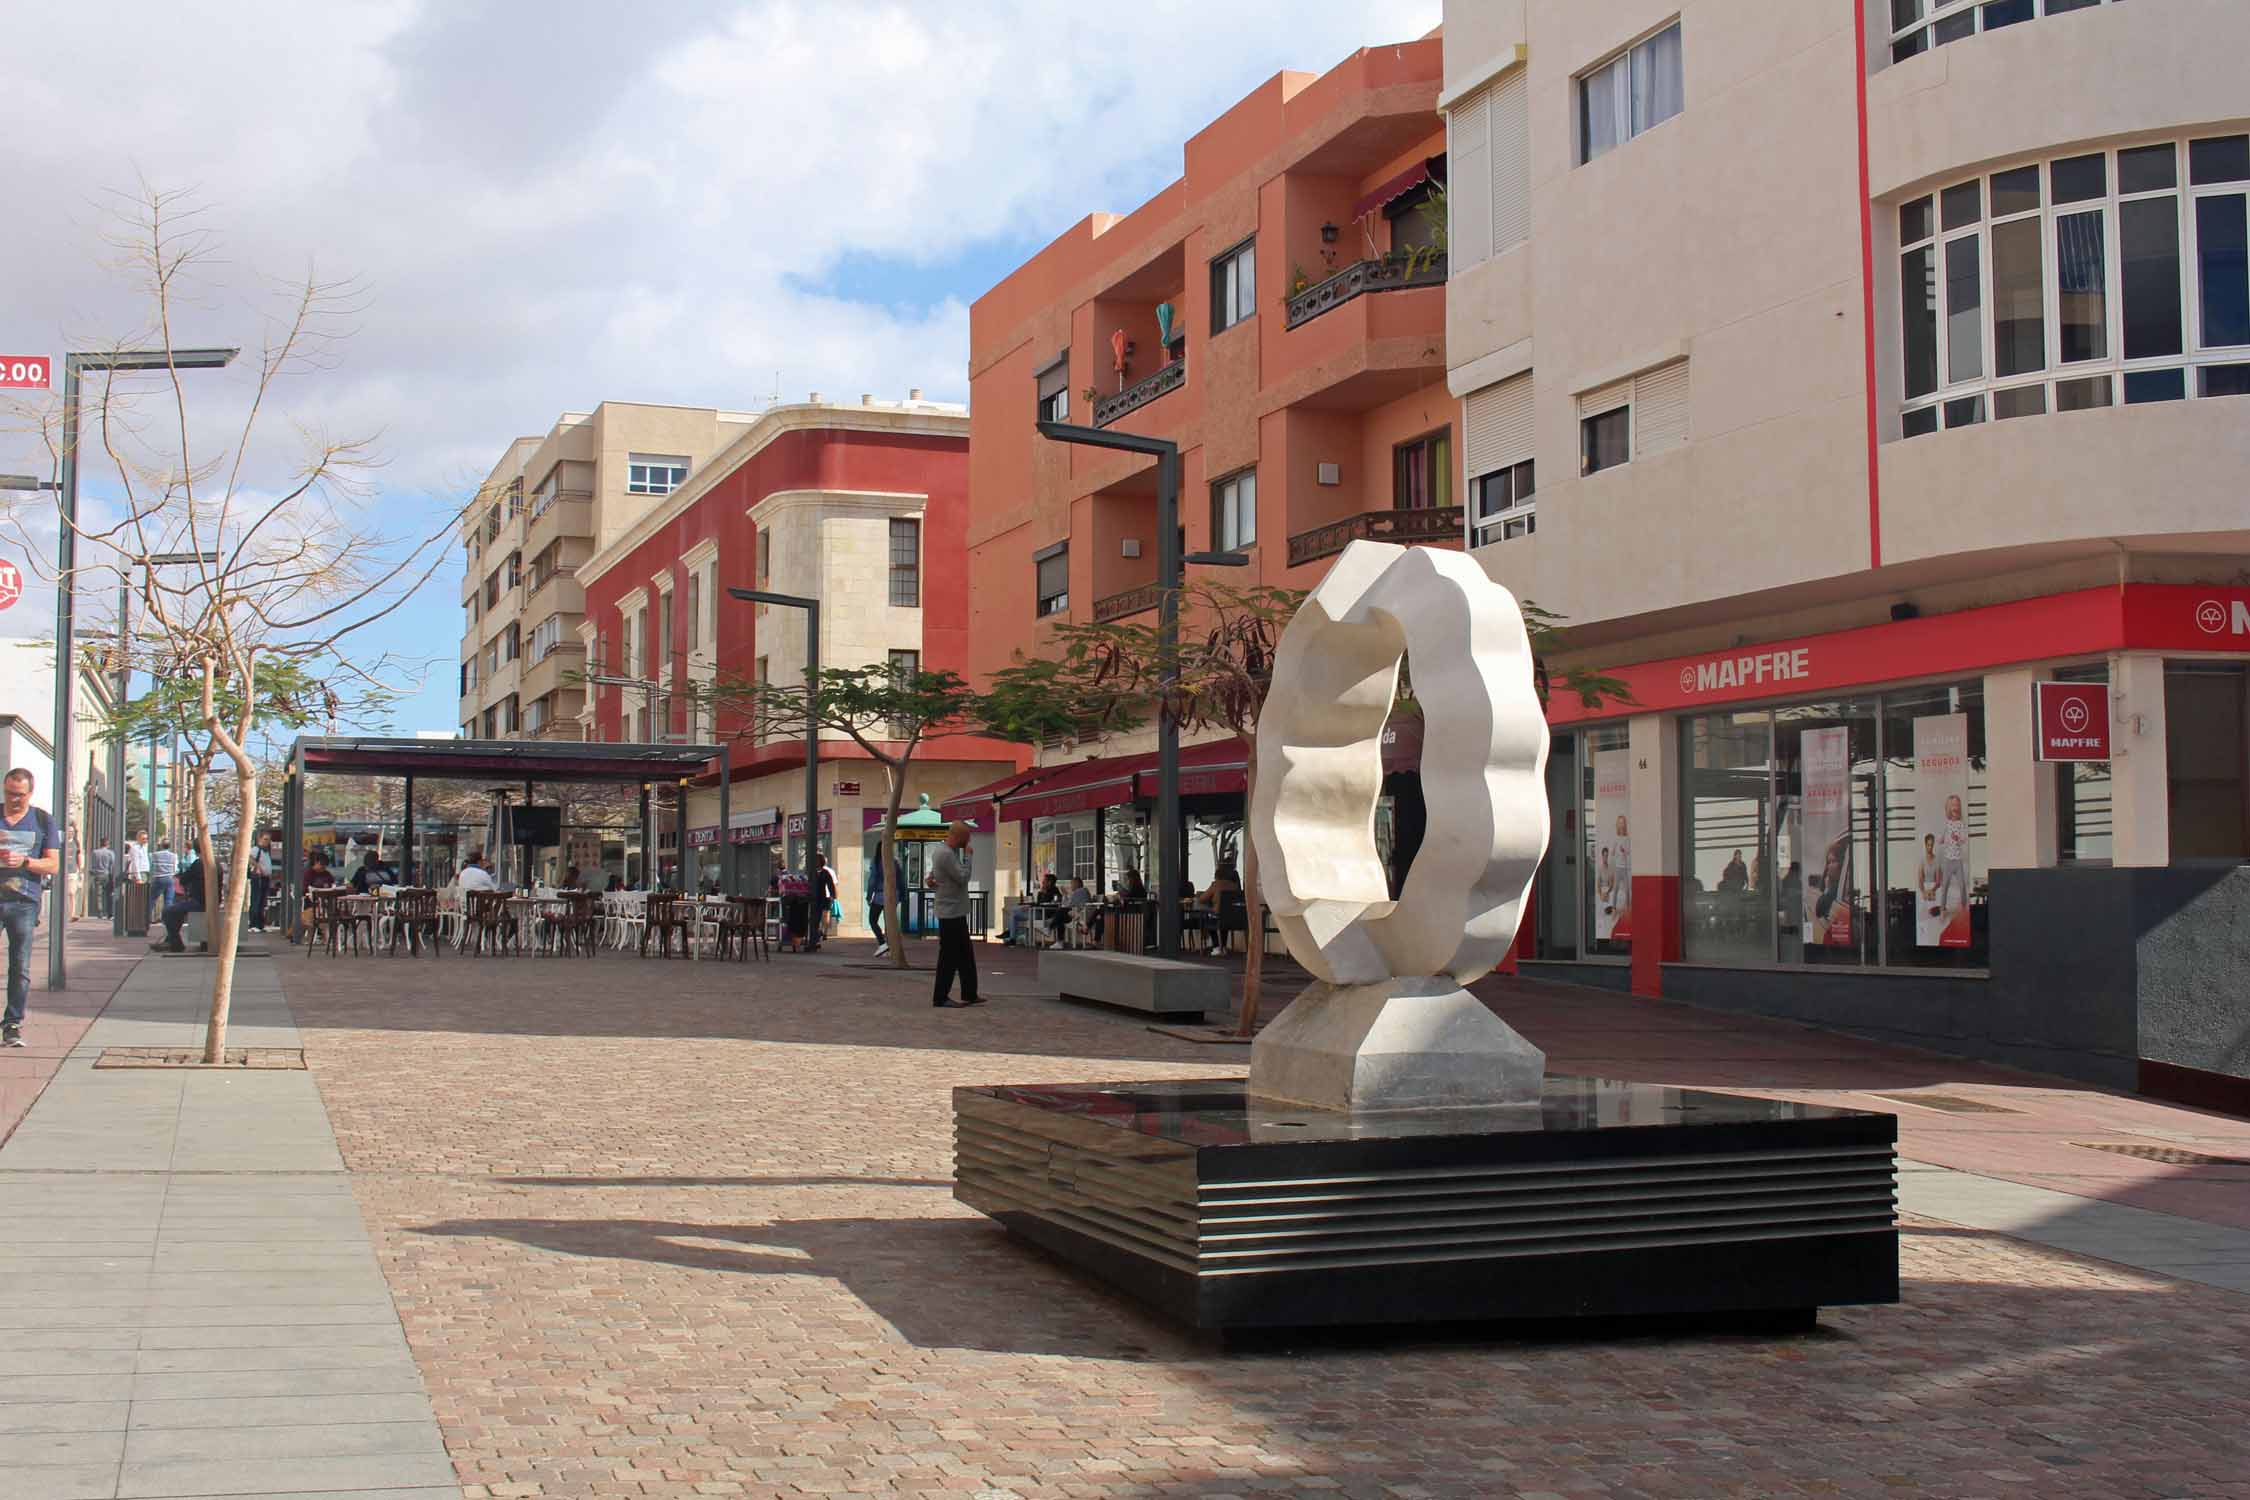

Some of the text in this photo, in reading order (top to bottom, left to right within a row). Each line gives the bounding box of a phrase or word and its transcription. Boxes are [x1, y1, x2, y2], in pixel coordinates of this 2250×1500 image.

[1697, 648, 1809, 691] MAPFRE
[1383, 728, 1395, 744] da
[2050, 738, 2102, 748] MAPFRE
